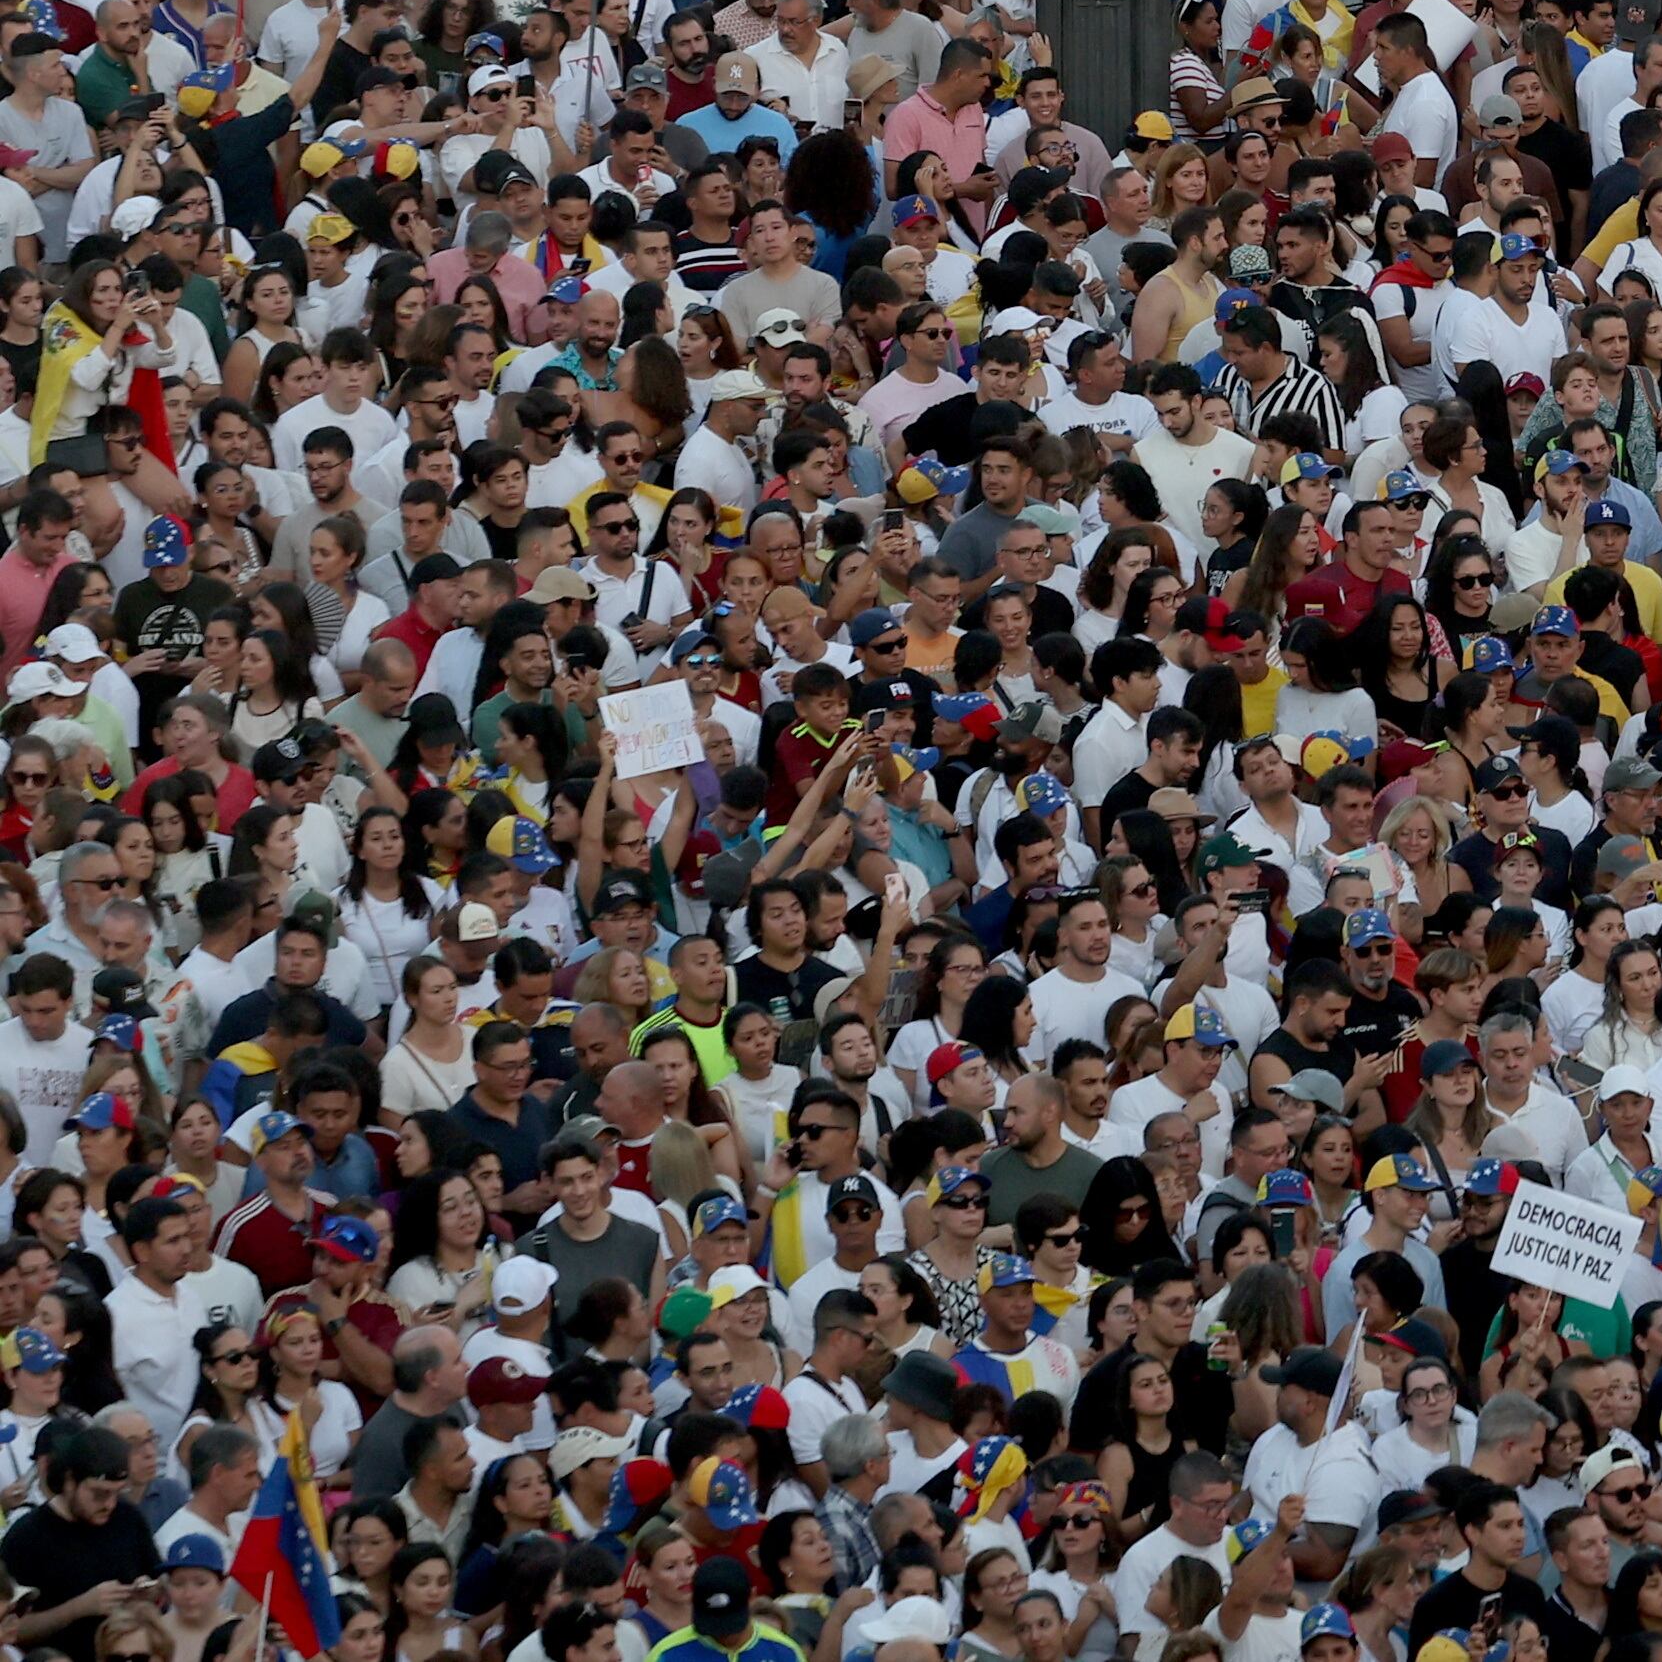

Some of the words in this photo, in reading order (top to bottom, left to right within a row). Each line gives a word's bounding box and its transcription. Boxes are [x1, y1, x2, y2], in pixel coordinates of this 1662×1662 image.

[1097, 418, 1128, 431] YORK
[1517, 1200, 1624, 1257] DEMOCRACIA,
[1504, 1232, 1570, 1270] JUSTICIA
[1572, 1251, 1584, 1273] Y
[1581, 1255, 1613, 1285] PAZ.
